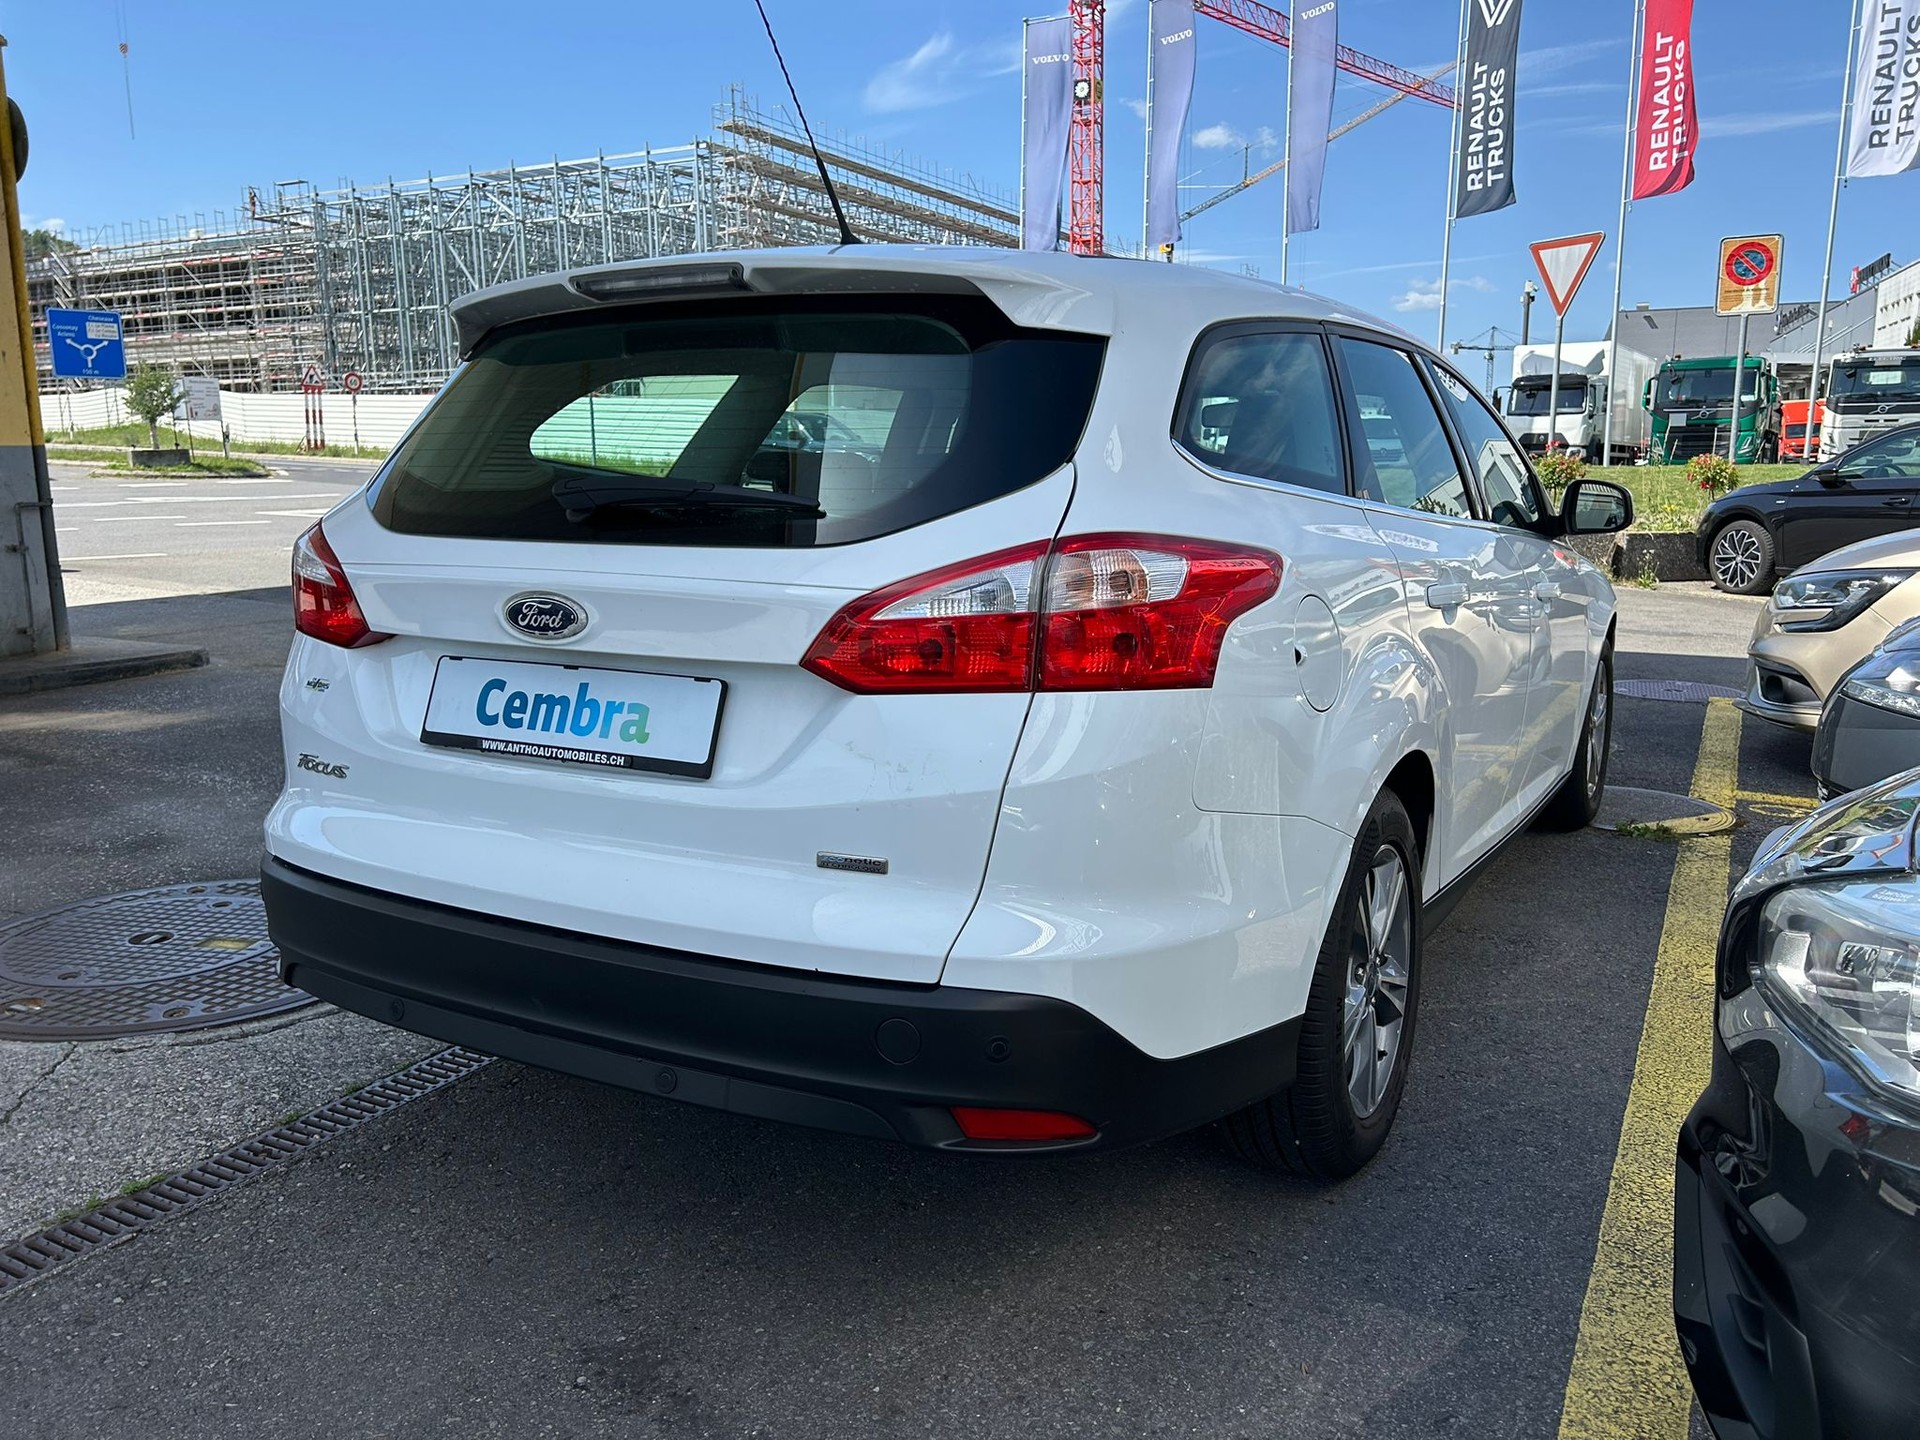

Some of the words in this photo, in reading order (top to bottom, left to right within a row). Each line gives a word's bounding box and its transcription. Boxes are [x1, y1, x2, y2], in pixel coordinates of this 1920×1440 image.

[1160, 29, 1193, 45] VOLVO
[1301, 2, 1334, 20] VOLVO
[1032, 53, 1070, 65] VOLVO
[1649, 31, 1674, 171] RENAULT
[1671, 39, 1689, 167] TRUCKS
[1868, 3, 1902, 149] RENAULT
[1895, 15, 1920, 145] TRUCKS
[1466, 61, 1488, 192] RENAULT
[1487, 68, 1506, 188] TRUCKS
[518, 601, 564, 629] Ford
[476, 678, 650, 744] Cembra
[482, 739, 625, 766] WWW.ANTHOAUTOMOBILES.CH
